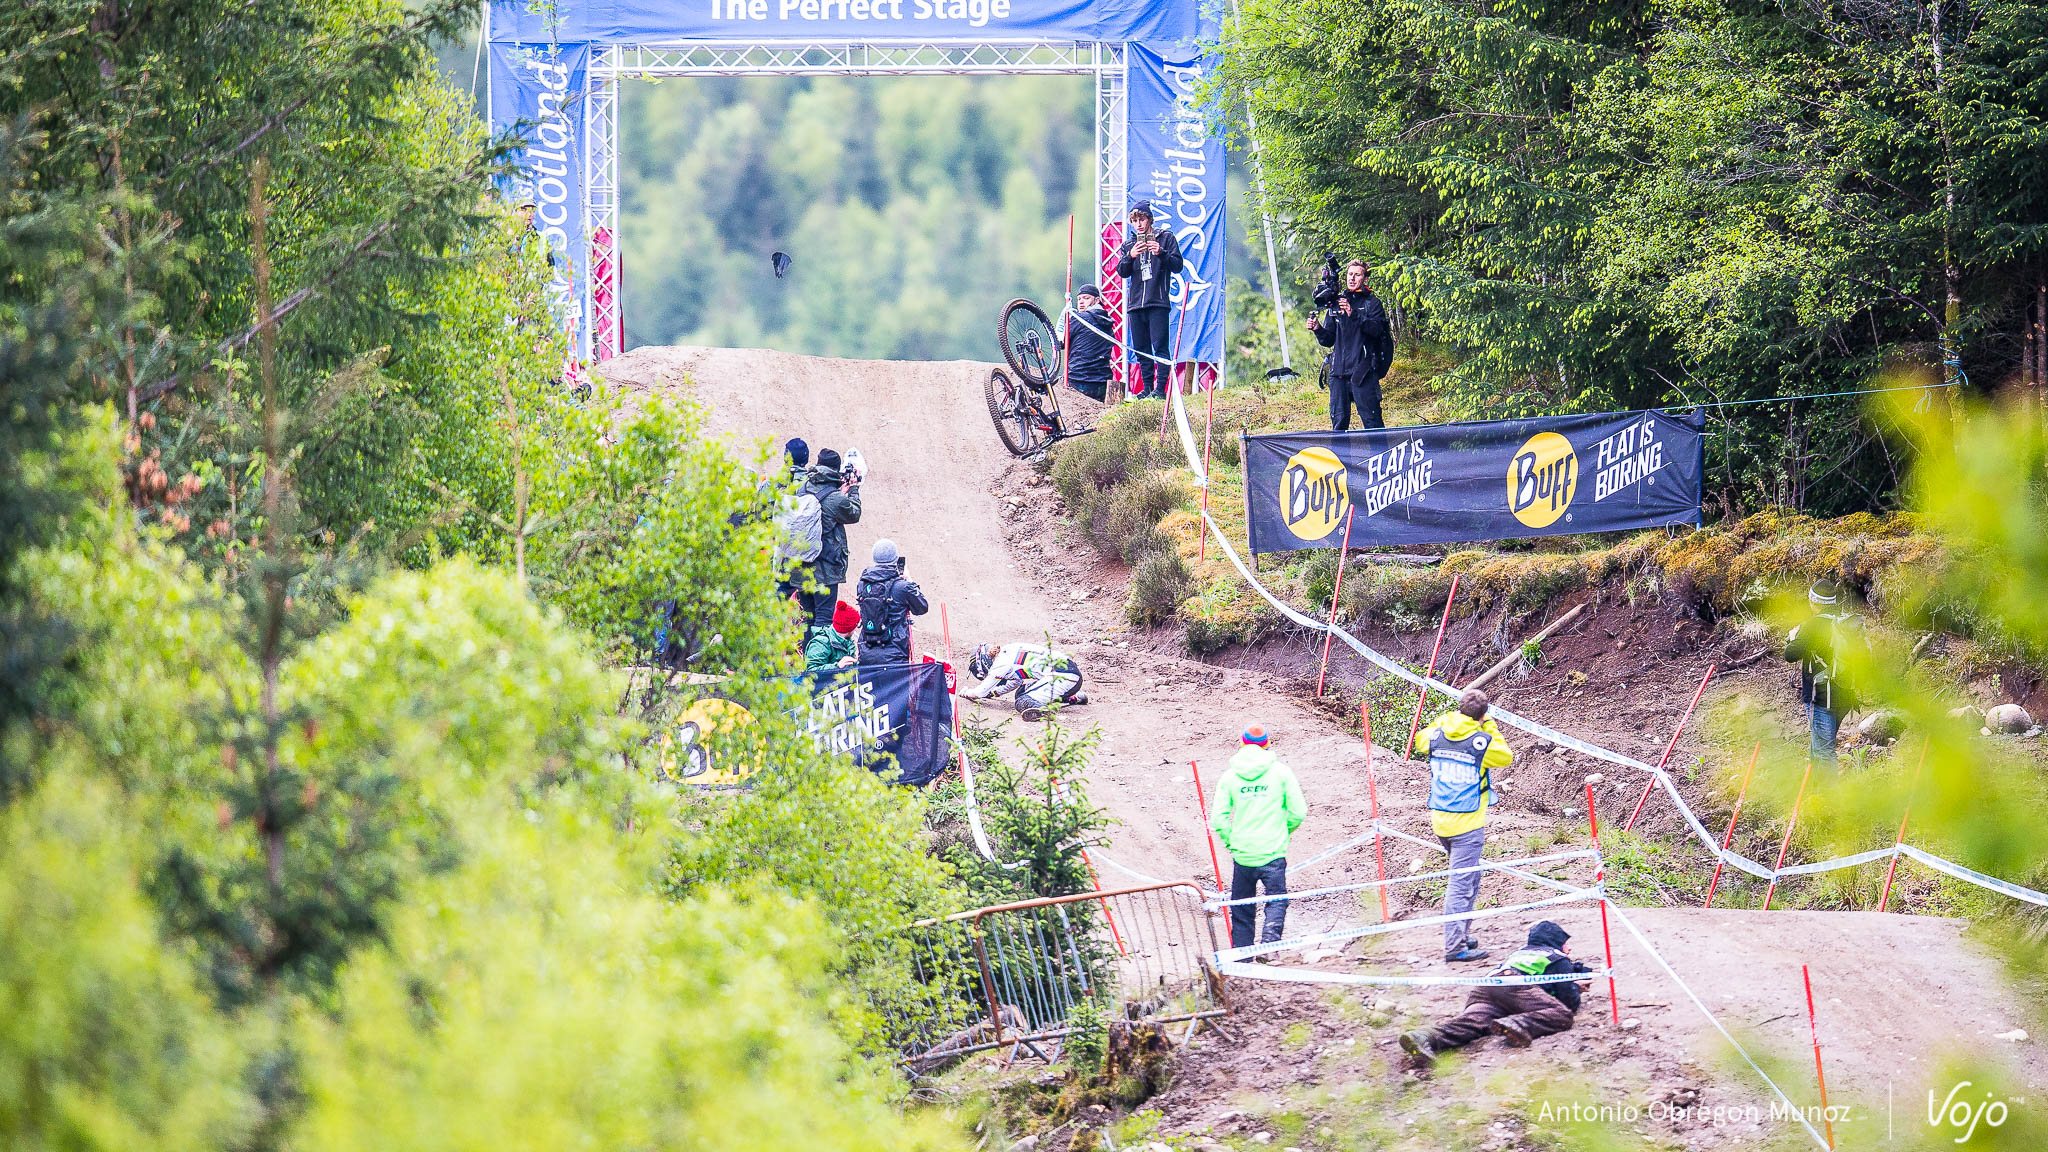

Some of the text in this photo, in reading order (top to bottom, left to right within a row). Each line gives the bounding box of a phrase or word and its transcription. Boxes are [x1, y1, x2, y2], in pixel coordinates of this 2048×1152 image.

[710, 0, 1012, 27] The Perfect Stage
[526, 60, 568, 250] Scotland
[1150, 169, 1173, 230] Visit
[1367, 438, 1424, 486] FLAT IS
[1594, 441, 1664, 503] BORING
[1597, 419, 1655, 471] FLAT IS
[1365, 461, 1431, 518] BORING
[854, 681, 874, 712] IS
